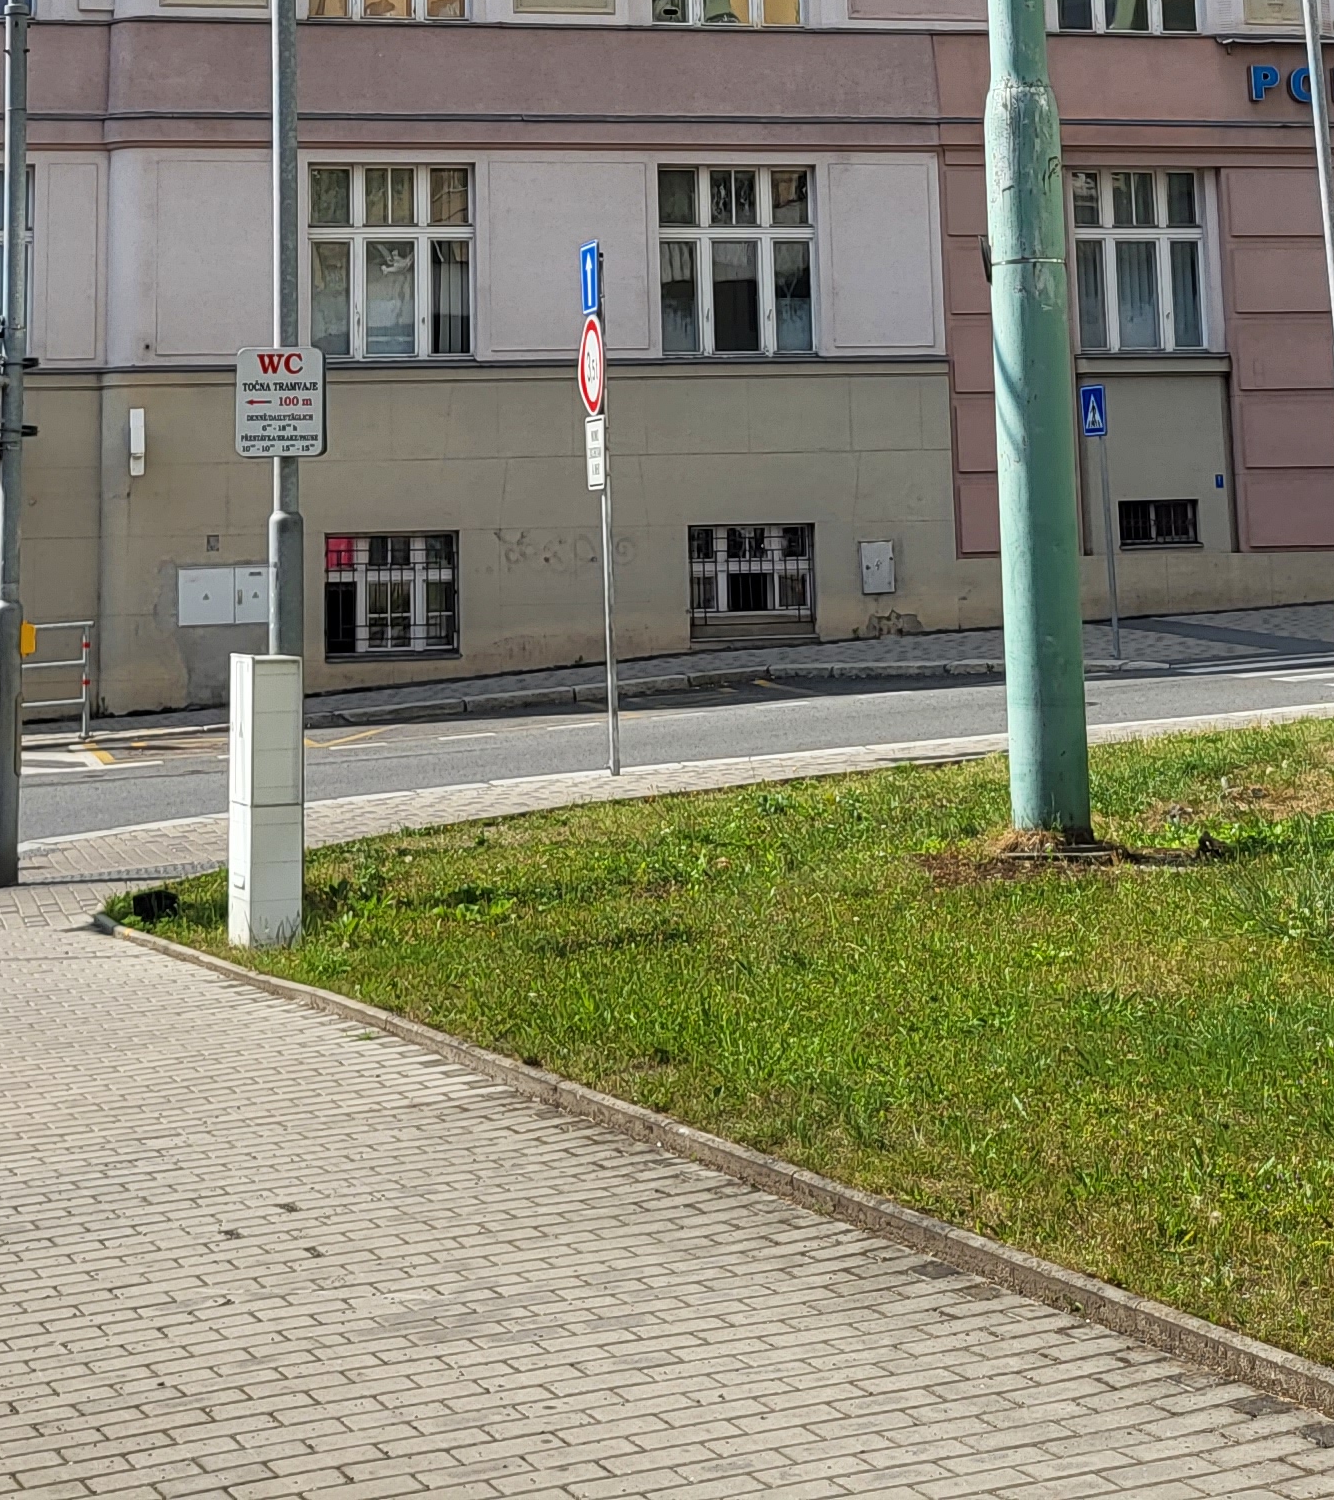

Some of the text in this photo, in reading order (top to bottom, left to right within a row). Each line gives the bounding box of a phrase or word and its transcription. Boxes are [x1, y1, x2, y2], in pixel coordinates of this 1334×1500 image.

[256, 352, 303, 375] WC
[242, 380, 318, 392] TOČNA TRAMVAJE
[279, 396, 313, 406] 100 m
